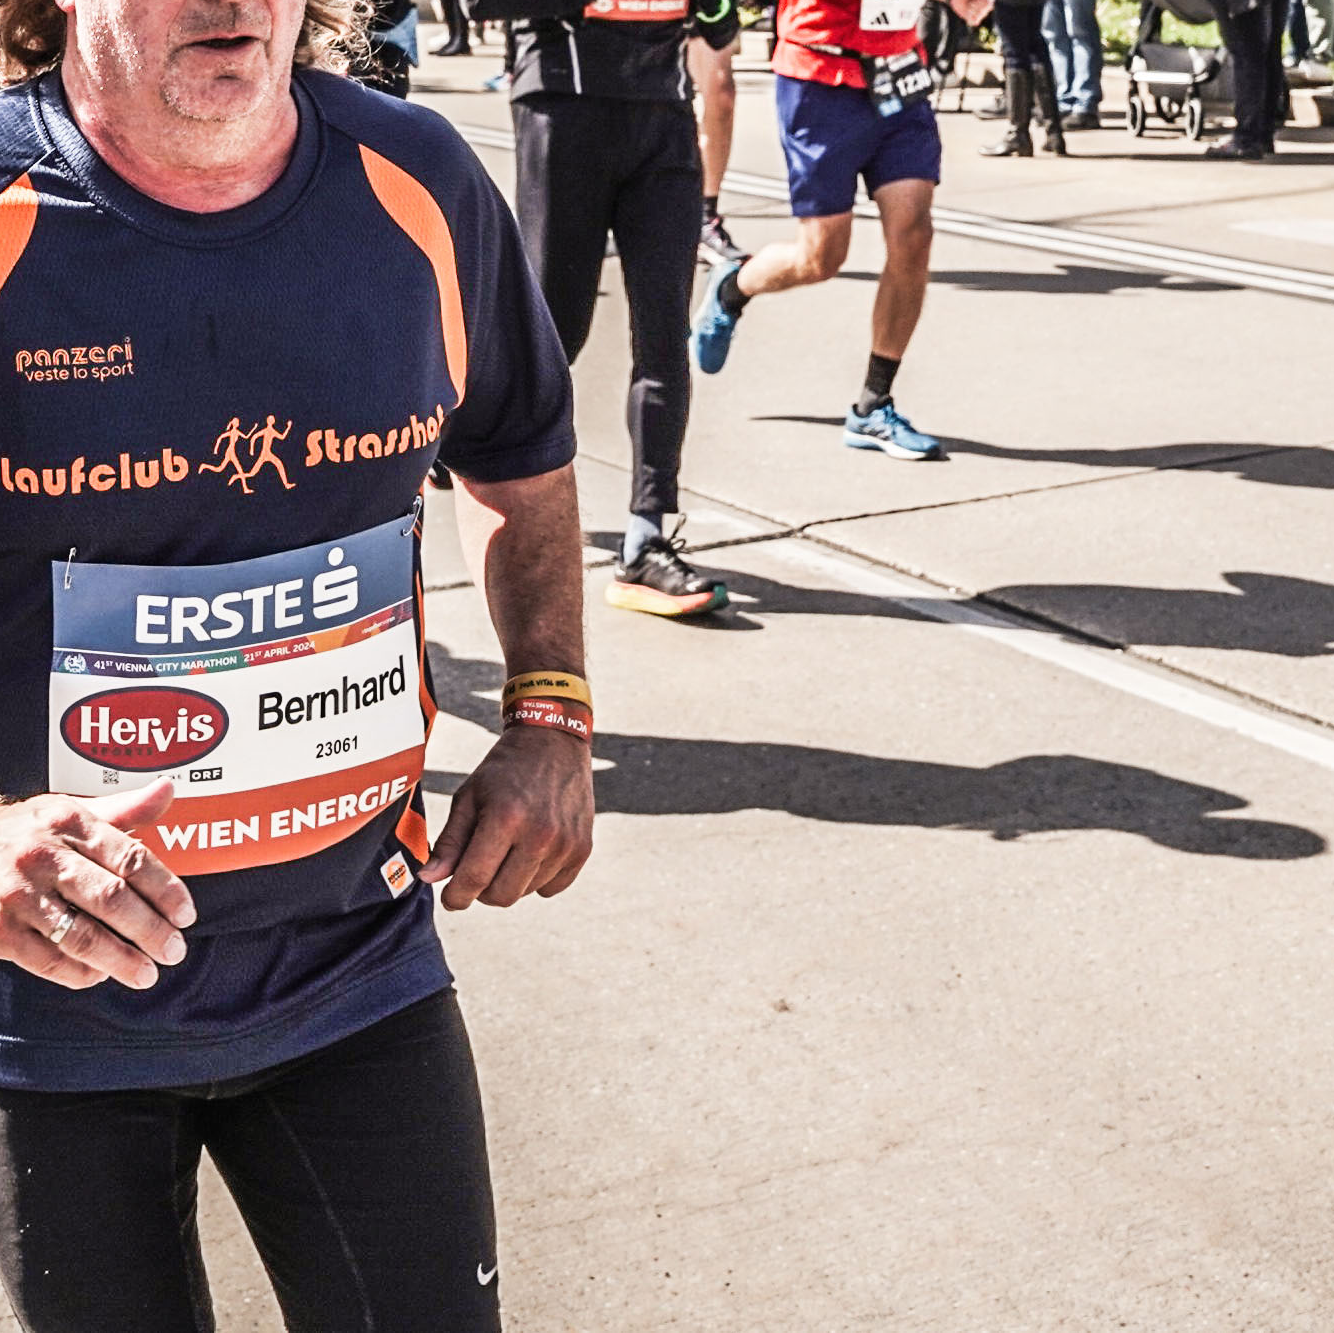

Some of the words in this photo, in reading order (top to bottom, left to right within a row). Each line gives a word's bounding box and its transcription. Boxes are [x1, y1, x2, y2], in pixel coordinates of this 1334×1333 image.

[15, 336, 133, 373] panzeri
[25, 367, 69, 382] veste
[73, 366, 88, 380] lo
[91, 361, 134, 382] sport
[135, 578, 304, 644] ERSTE
[116, 662, 154, 673] VIENNA
[156, 662, 180, 672] CITY
[181, 656, 238, 670] MARATHON
[264, 646, 291, 659] APRIL
[292, 641, 316, 653] 2024
[258, 654, 406, 731] Bernhard
[80, 705, 215, 752] Hervis
[515, 709, 543, 721] Area
[544, 713, 565, 726] VIP
[315, 734, 359, 759] 23061
[191, 768, 222, 781] ORF
[156, 815, 260, 852] WIEN
[270, 775, 409, 838] ENERGIE
